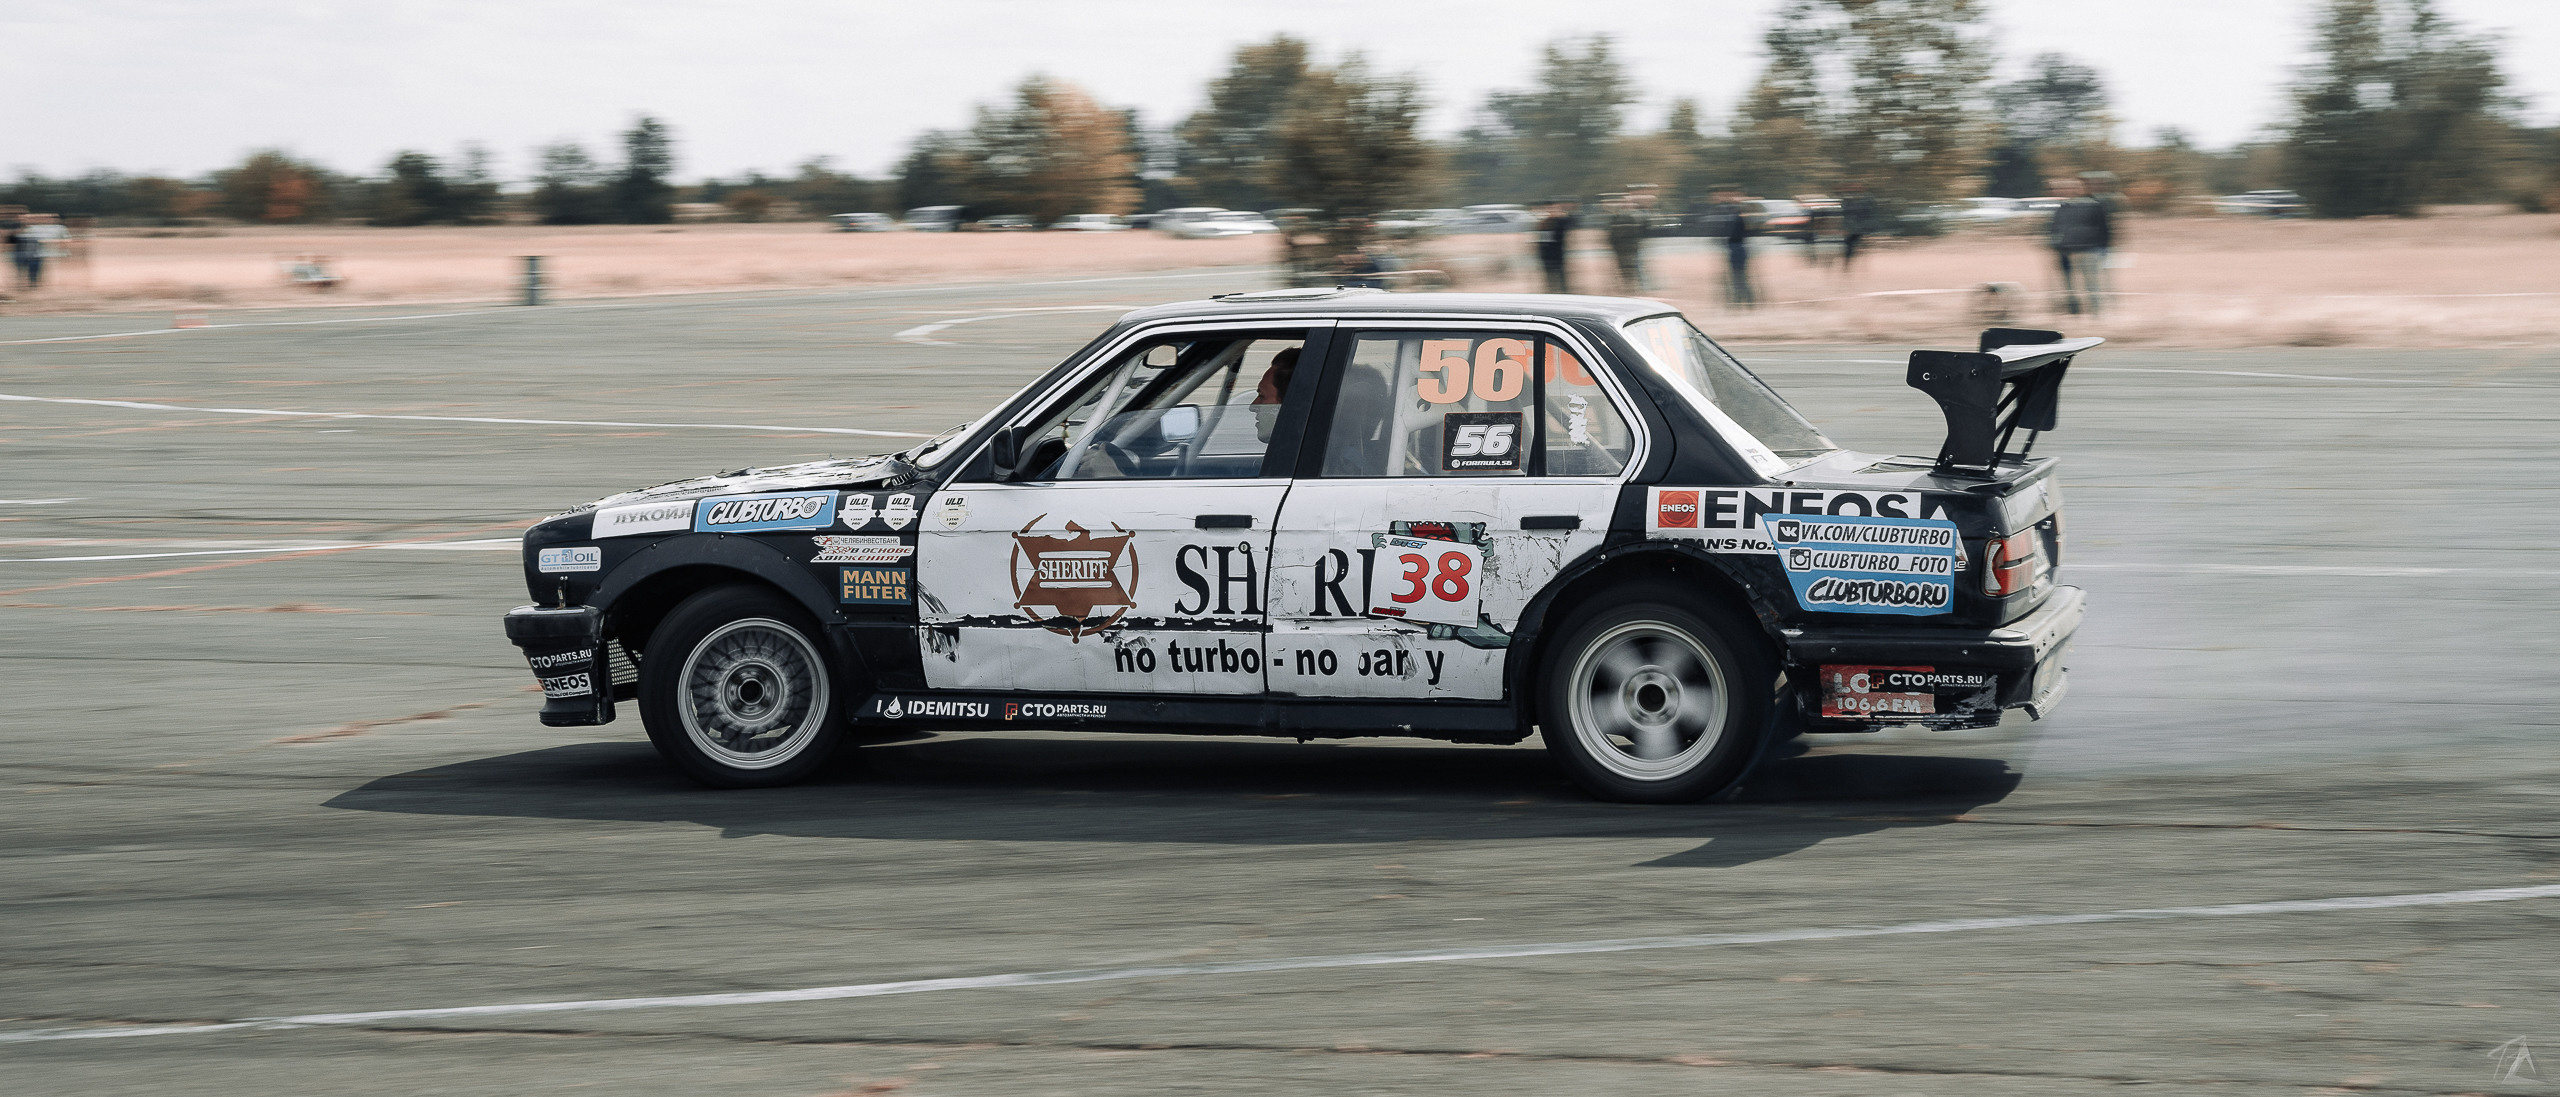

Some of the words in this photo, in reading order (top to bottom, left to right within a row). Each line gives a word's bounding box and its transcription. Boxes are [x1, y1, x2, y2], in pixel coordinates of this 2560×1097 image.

[1417, 338, 1527, 404] 56
[1450, 423, 1515, 457] 56
[707, 495, 829, 526] CLUBTURBO
[849, 498, 869, 506] ULD
[891, 498, 911, 506] ULD
[945, 498, 964, 506] ULD
[1660, 503, 1696, 513] ENEOS
[1801, 524, 1951, 546] VK.COM/CLUBTURBO
[541, 554, 560, 563] GT
[574, 552, 598, 562] OIL
[1813, 552, 1949, 574] CLUBTURBO_FOTO
[843, 570, 906, 585] MANN
[1039, 560, 1109, 580] SHERIFF
[1390, 551, 1473, 604] 38
[843, 585, 907, 600] FILTER
[1807, 578, 1948, 607] CLUBTURBO.RU
[1114, 647, 1157, 674] no
[1167, 638, 1261, 675] turbo
[1295, 649, 1338, 677] no
[543, 674, 589, 691] ENEOS
[907, 700, 990, 718] IDEMITSU
[1836, 697, 1889, 711] 106.6
[1892, 698, 1922, 713] FM
